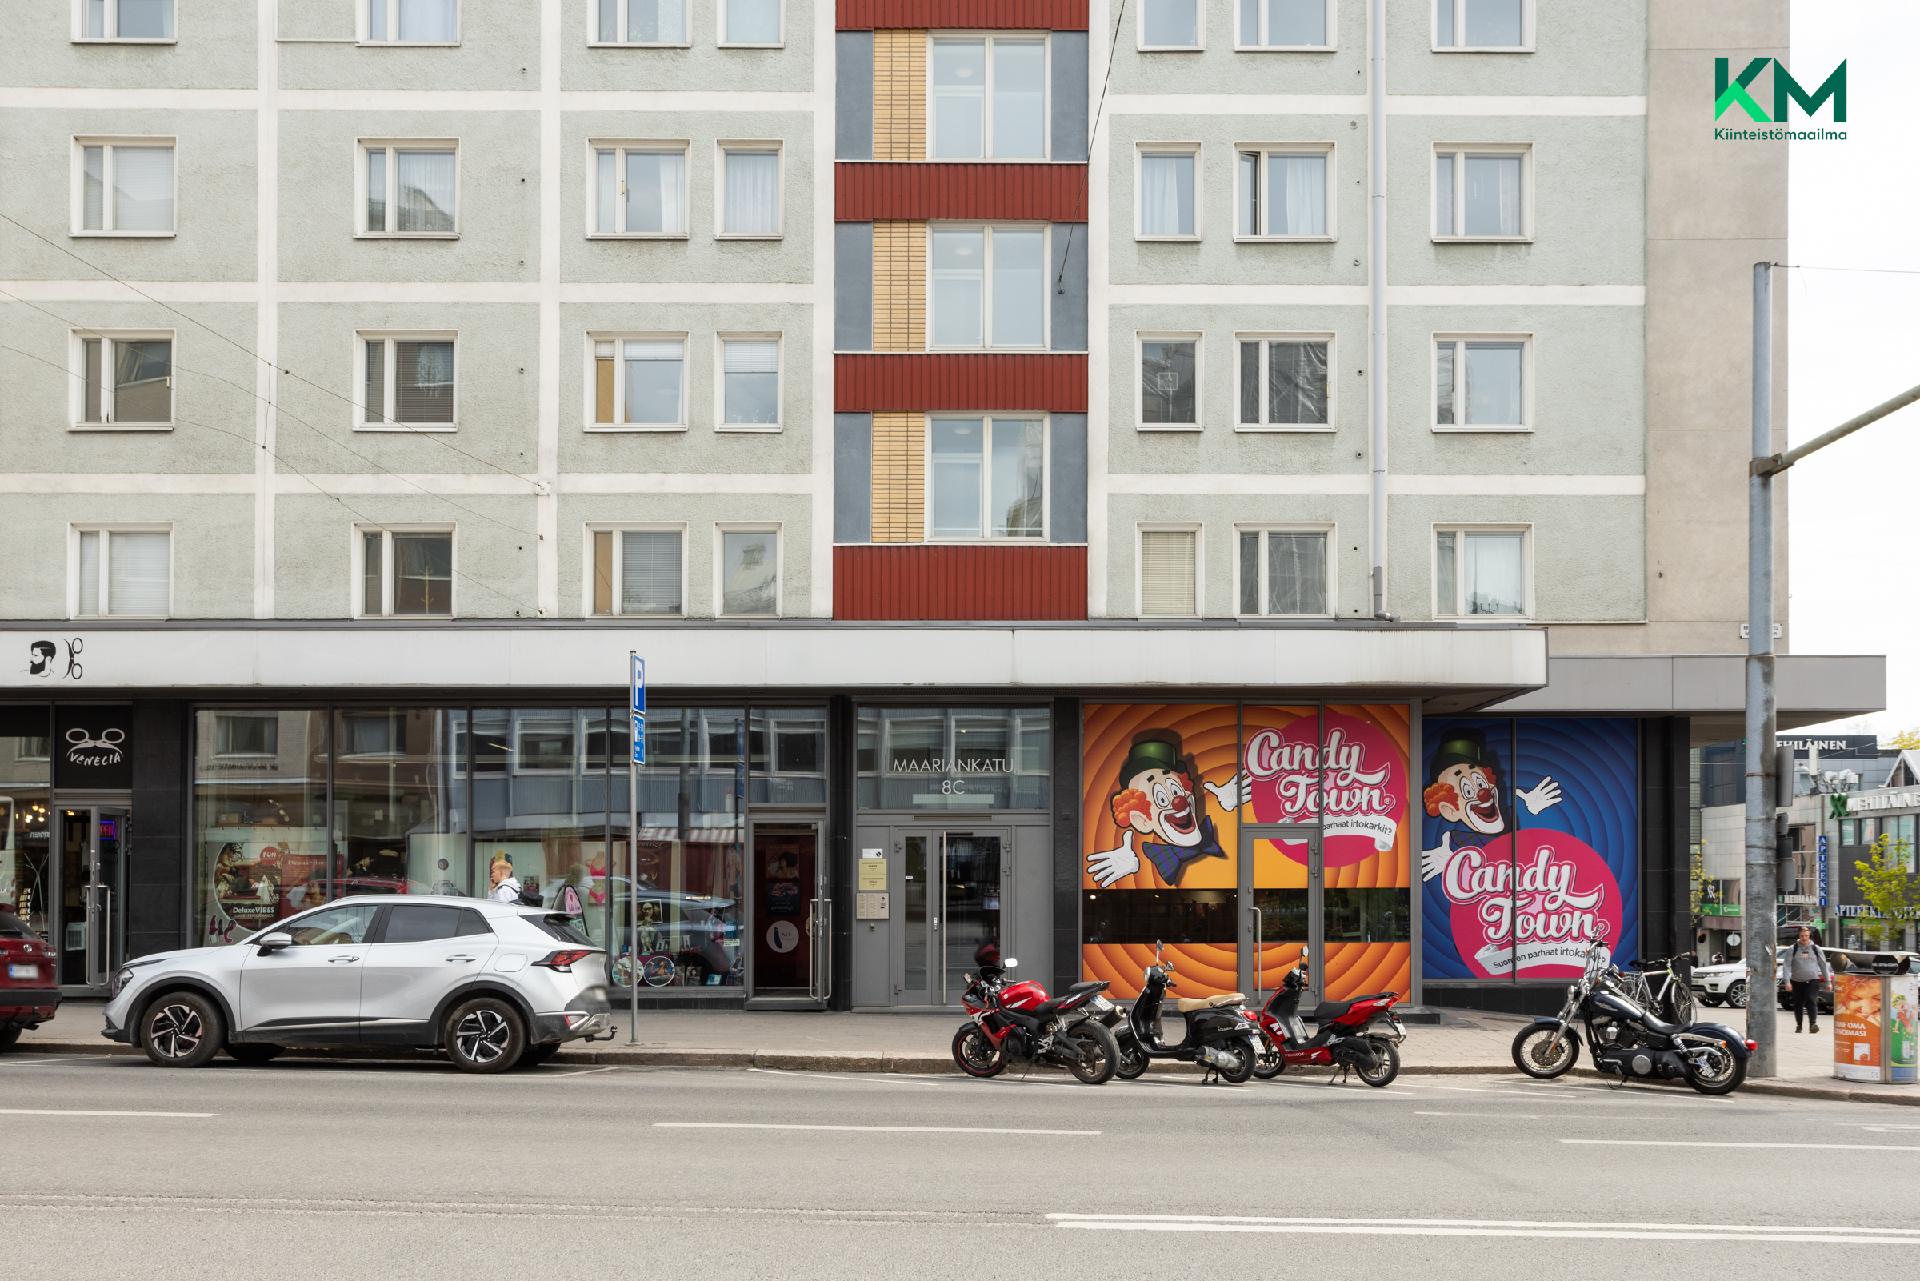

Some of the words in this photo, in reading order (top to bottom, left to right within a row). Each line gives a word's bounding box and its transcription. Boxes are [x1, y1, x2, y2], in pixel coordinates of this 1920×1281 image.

[635, 659, 643, 706] P
[1776, 738, 1847, 750] EHILÄINEN
[893, 758, 1014, 773] MAARIANKATU
[1247, 731, 1387, 786] Candy
[941, 779, 965, 795] 8C
[1846, 792, 1920, 811] MEHILÄINE
[1445, 849, 1600, 910] Candy
[1527, 946, 1558, 960] parhaat
